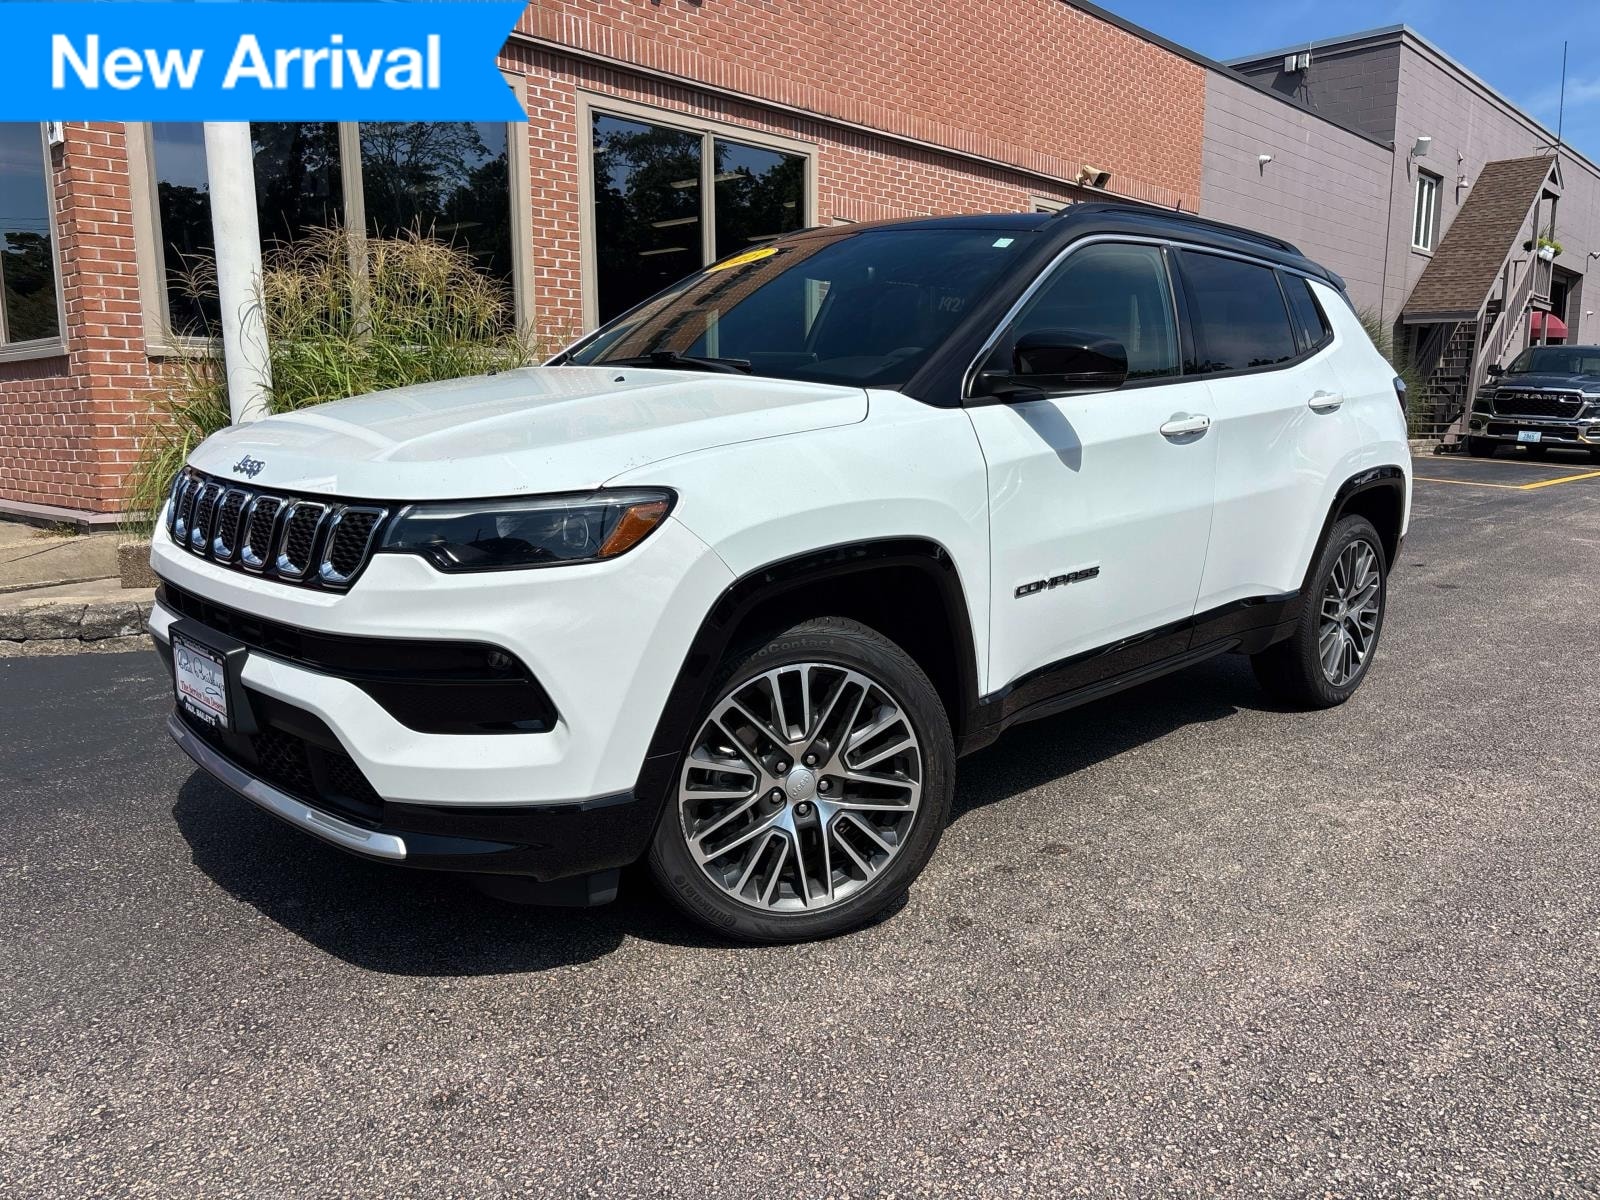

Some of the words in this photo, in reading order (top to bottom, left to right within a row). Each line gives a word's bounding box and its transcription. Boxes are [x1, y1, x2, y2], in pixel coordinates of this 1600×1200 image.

[1515, 393, 1558, 401] RAM
[233, 454, 266, 479] Jeep
[1014, 565, 1100, 599] COMPASS
[792, 774, 810, 797] Jeep
